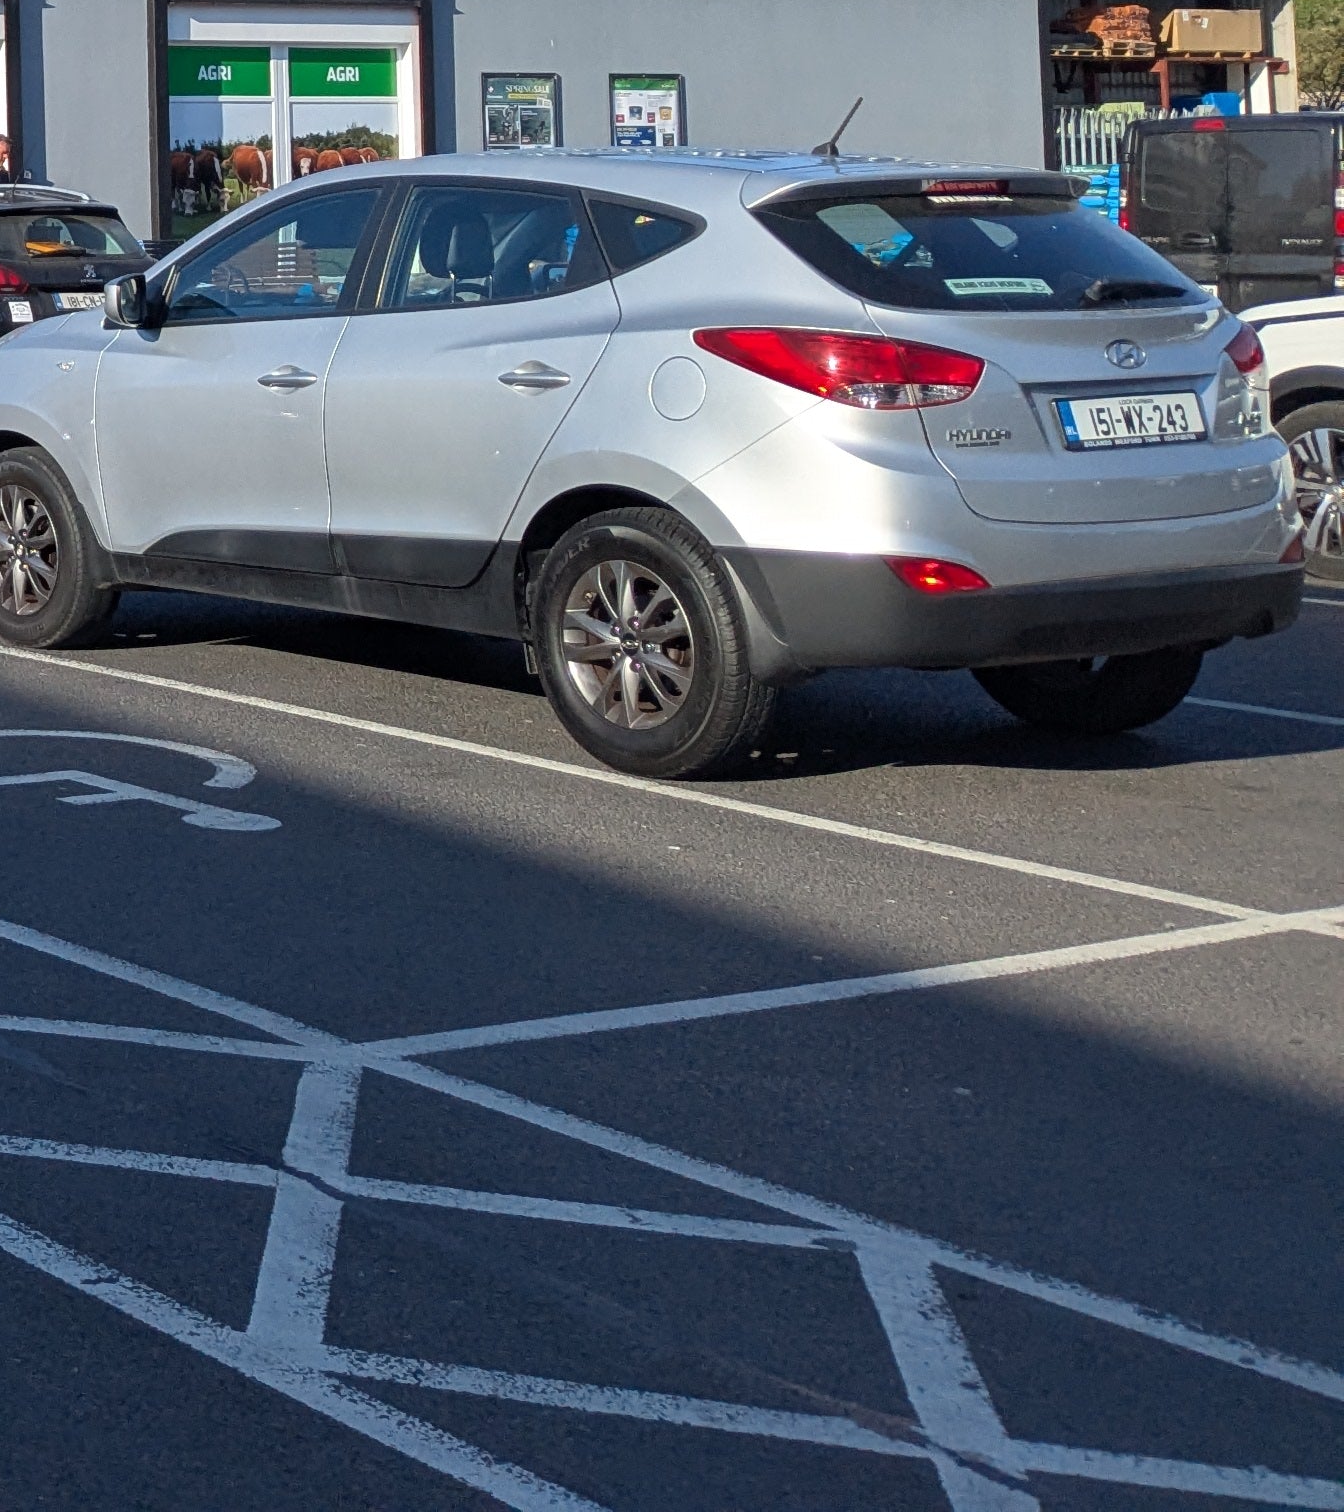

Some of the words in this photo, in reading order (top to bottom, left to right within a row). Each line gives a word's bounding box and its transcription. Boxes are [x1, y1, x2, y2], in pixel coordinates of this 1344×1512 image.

[198, 65, 232, 80] AGRI
[326, 66, 360, 81] AGRI
[1089, 403, 1189, 436] 151-WX-243
[946, 428, 1011, 441] HYUNDAI
